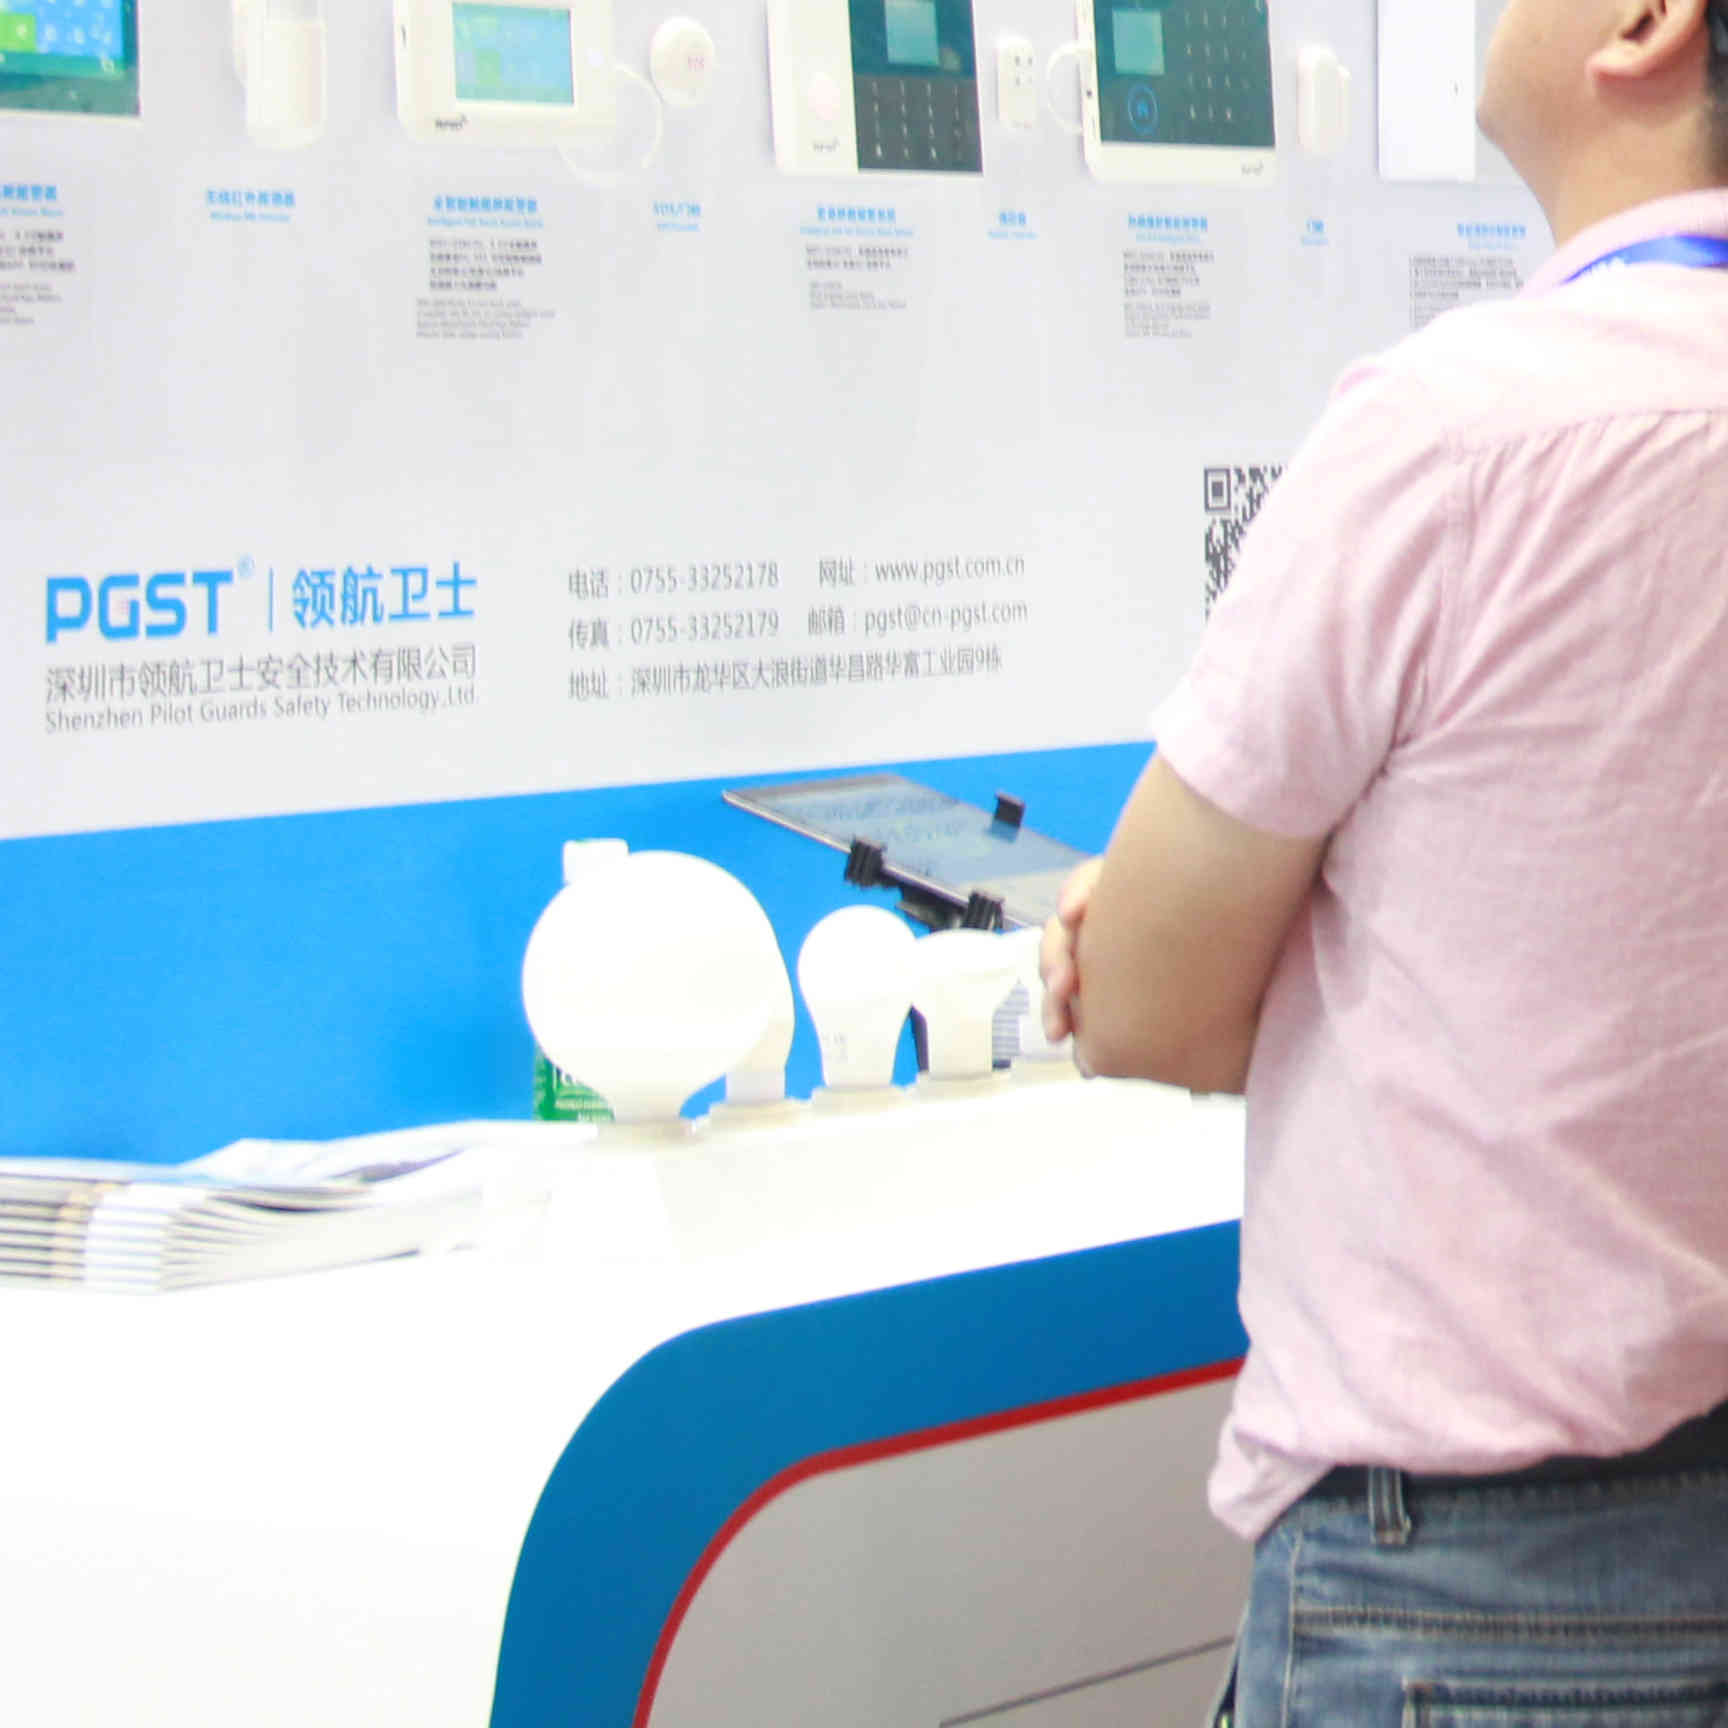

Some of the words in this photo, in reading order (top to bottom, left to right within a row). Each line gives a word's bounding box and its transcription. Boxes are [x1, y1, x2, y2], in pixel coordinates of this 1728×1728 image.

[45, 569, 234, 644] PGST
[292, 561, 478, 632] 领航卫士
[45, 642, 478, 704] 深圳市领航卫士安全技术有限公司
[45, 708, 144, 736] Shenzhen
[150, 702, 193, 726] Pilot
[199, 696, 268, 723] Guards
[274, 690, 331, 722] Safety
